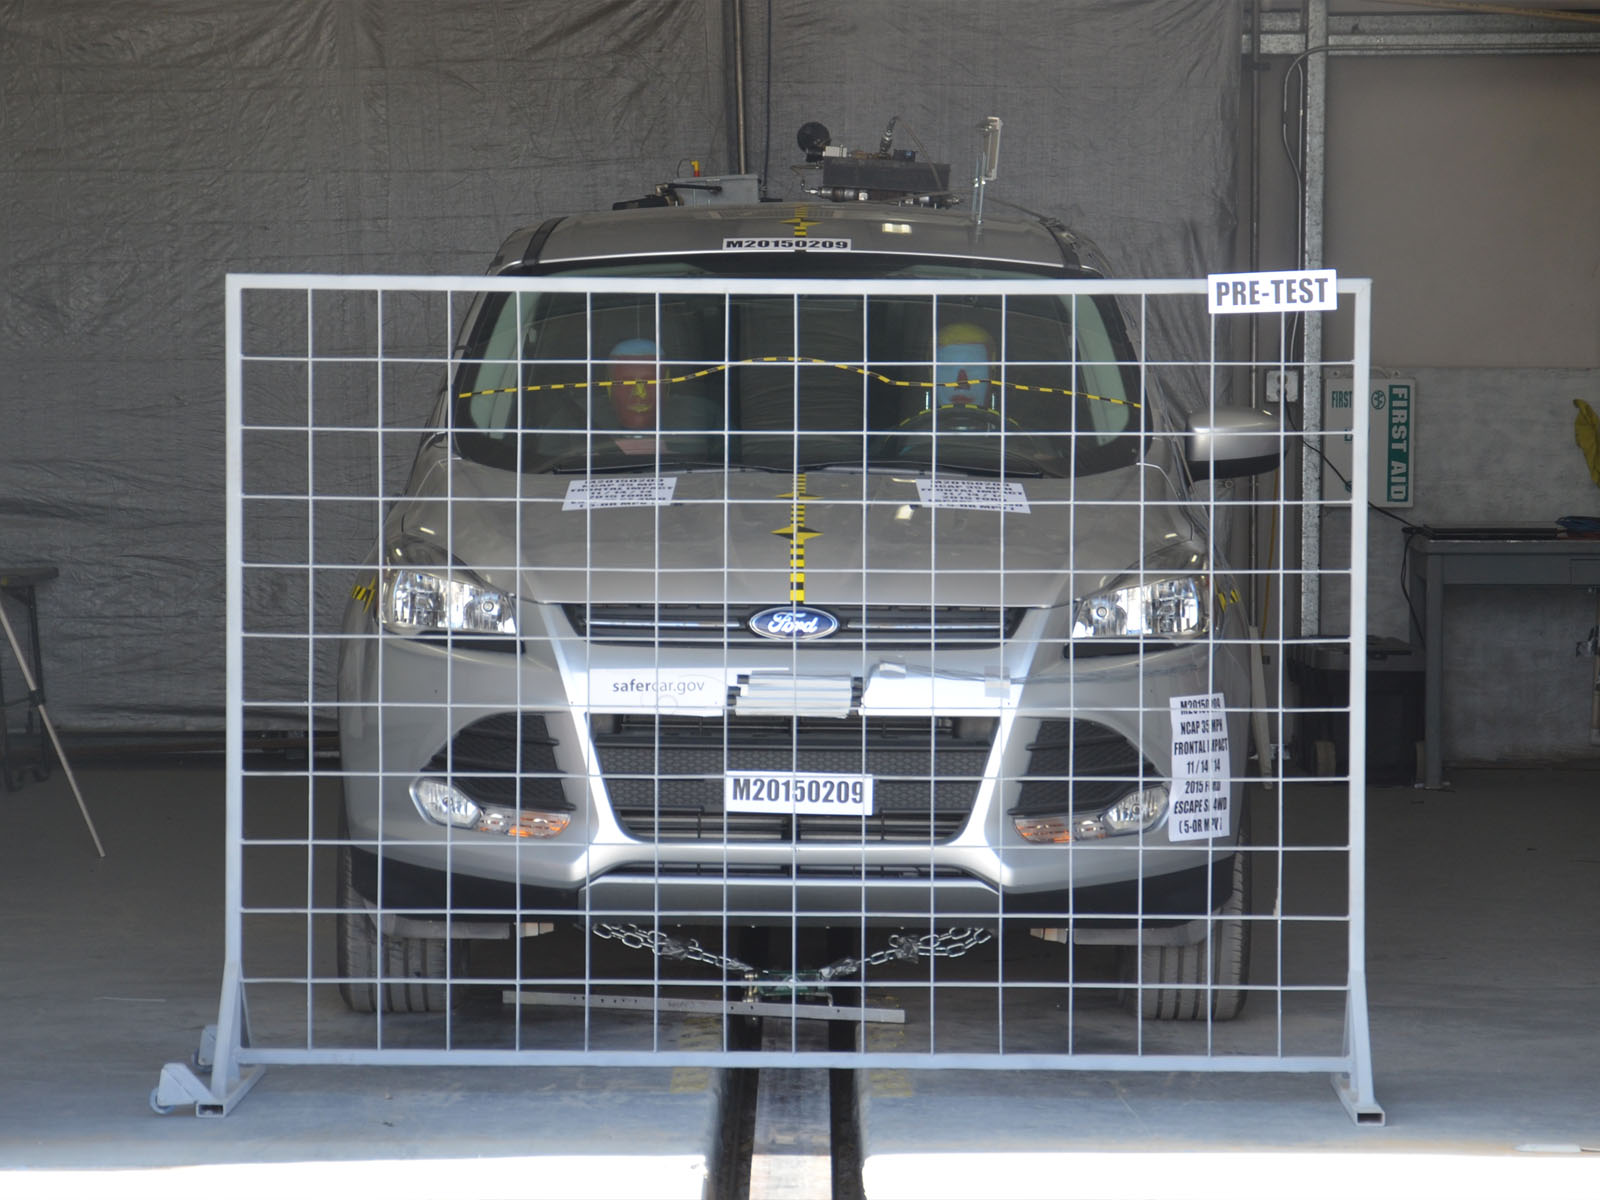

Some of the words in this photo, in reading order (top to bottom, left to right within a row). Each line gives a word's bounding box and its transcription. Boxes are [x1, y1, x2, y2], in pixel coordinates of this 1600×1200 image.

[726, 240, 848, 249] M20150209
[1216, 278, 1328, 306] PRE-TEST
[1331, 390, 1353, 409] FIRST
[1391, 387, 1408, 453] FIRST
[1390, 460, 1407, 500] AID
[767, 611, 819, 633] Ford
[612, 678, 705, 695] safercar.gov
[1180, 697, 1221, 715] M2015009
[1180, 720, 1200, 735] NCAP
[1201, 719, 1210, 734] 35
[1174, 739, 1206, 756] FRONTAL
[1187, 758, 1221, 775] 11/1414
[732, 778, 864, 804] M20150209
[1185, 780, 1204, 794] 2015
[1205, 780, 1221, 792] FRD
[1174, 798, 1203, 815] ESCAPE
[1213, 797, 1228, 811] 4WD
